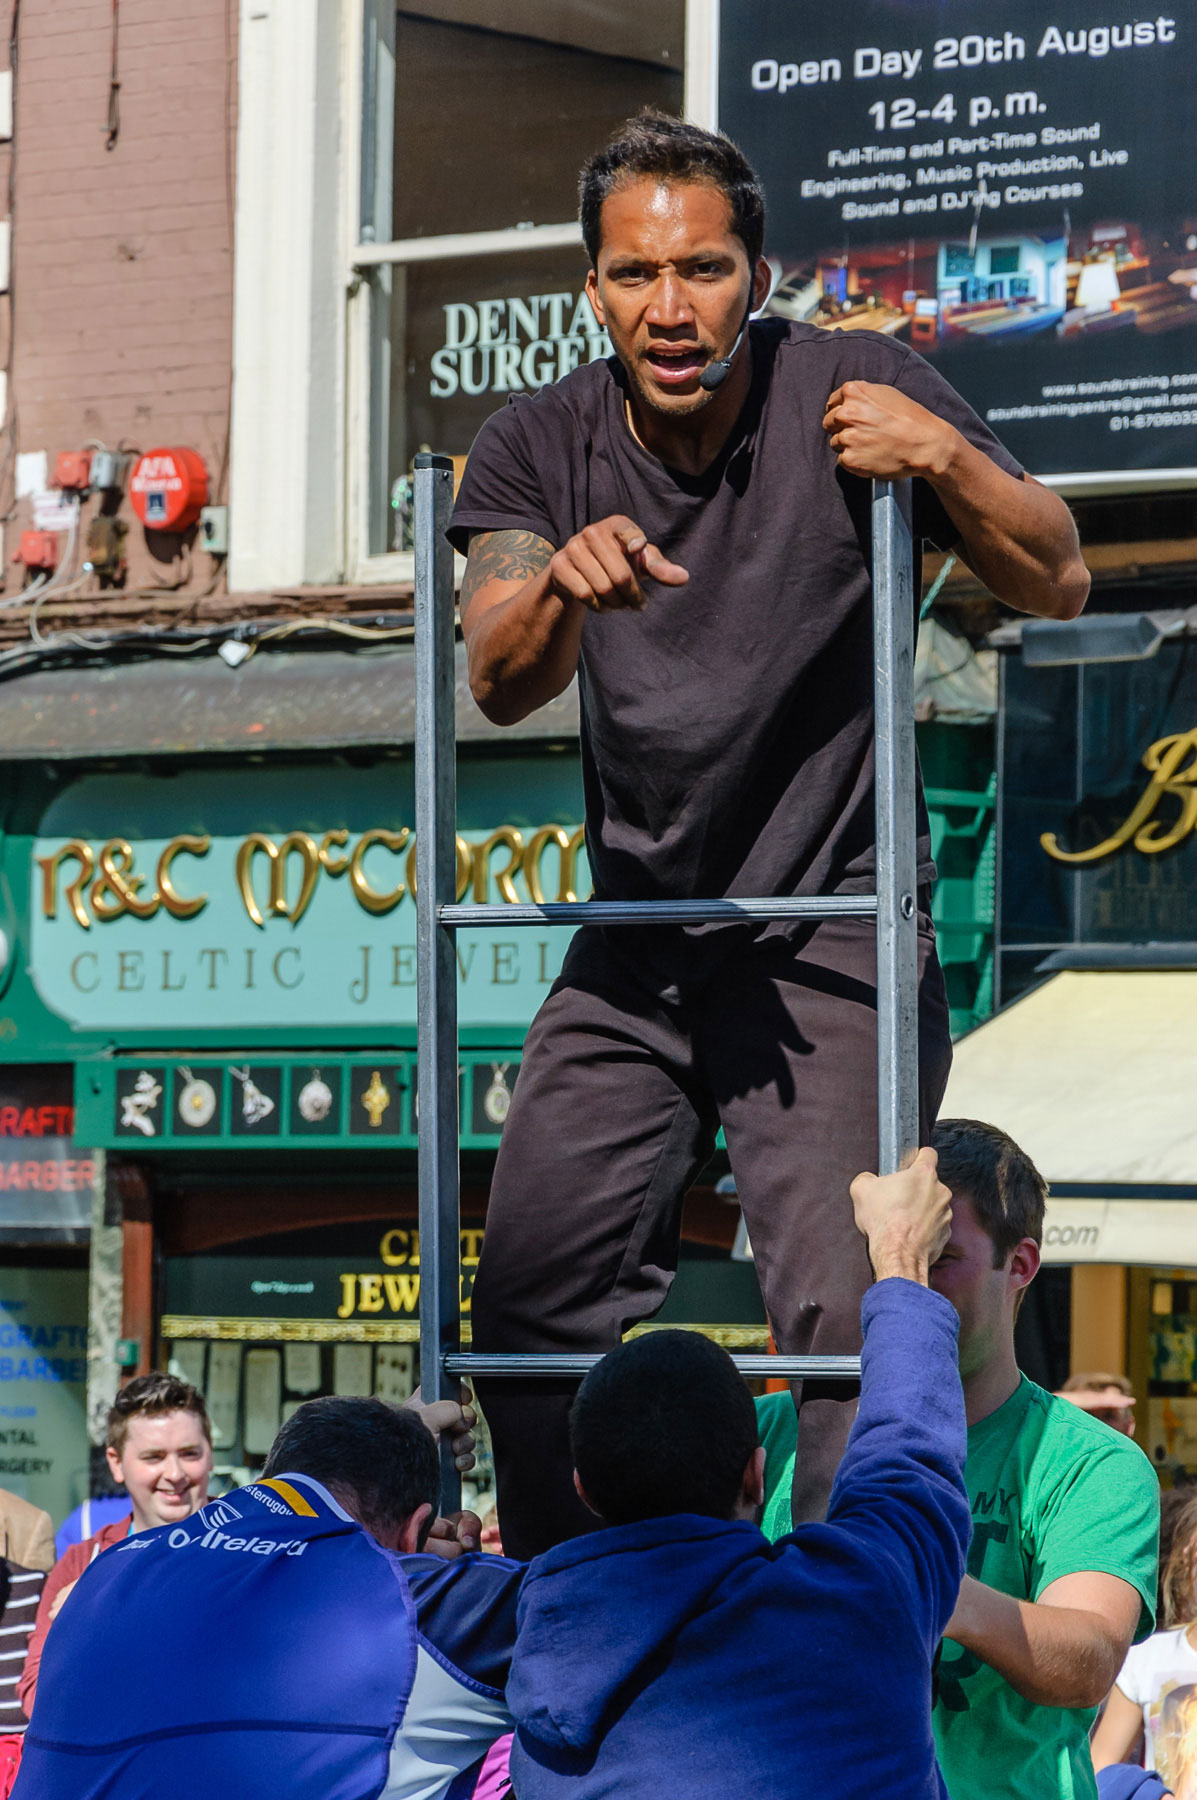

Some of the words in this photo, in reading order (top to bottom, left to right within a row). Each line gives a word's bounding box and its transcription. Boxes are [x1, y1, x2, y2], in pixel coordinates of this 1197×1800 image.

[751, 59, 841, 92] Open
[854, 47, 923, 79] Day
[933, 33, 1025, 70] 20th
[1037, 16, 1177, 58] August
[868, 94, 957, 131] 12-4
[969, 90, 1047, 127] p.m.
[827, 146, 906, 168] Full-Time
[910, 140, 944, 159] and
[948, 132, 1036, 156] Part-Time
[1041, 123, 1100, 146] Sound
[801, 173, 912, 198] Engineering,
[916, 165, 972, 186] Music
[976, 154, 1085, 180] Production,
[1090, 149, 1129, 168] Live
[841, 199, 900, 220] Sound
[903, 194, 938, 213] and
[1005, 181, 1083, 204] Courses
[442, 291, 609, 350] DENTA
[36, 834, 210, 928] R&C
[70, 947, 304, 993] CELTIC
[0, 1160, 96, 1192] ARBER
